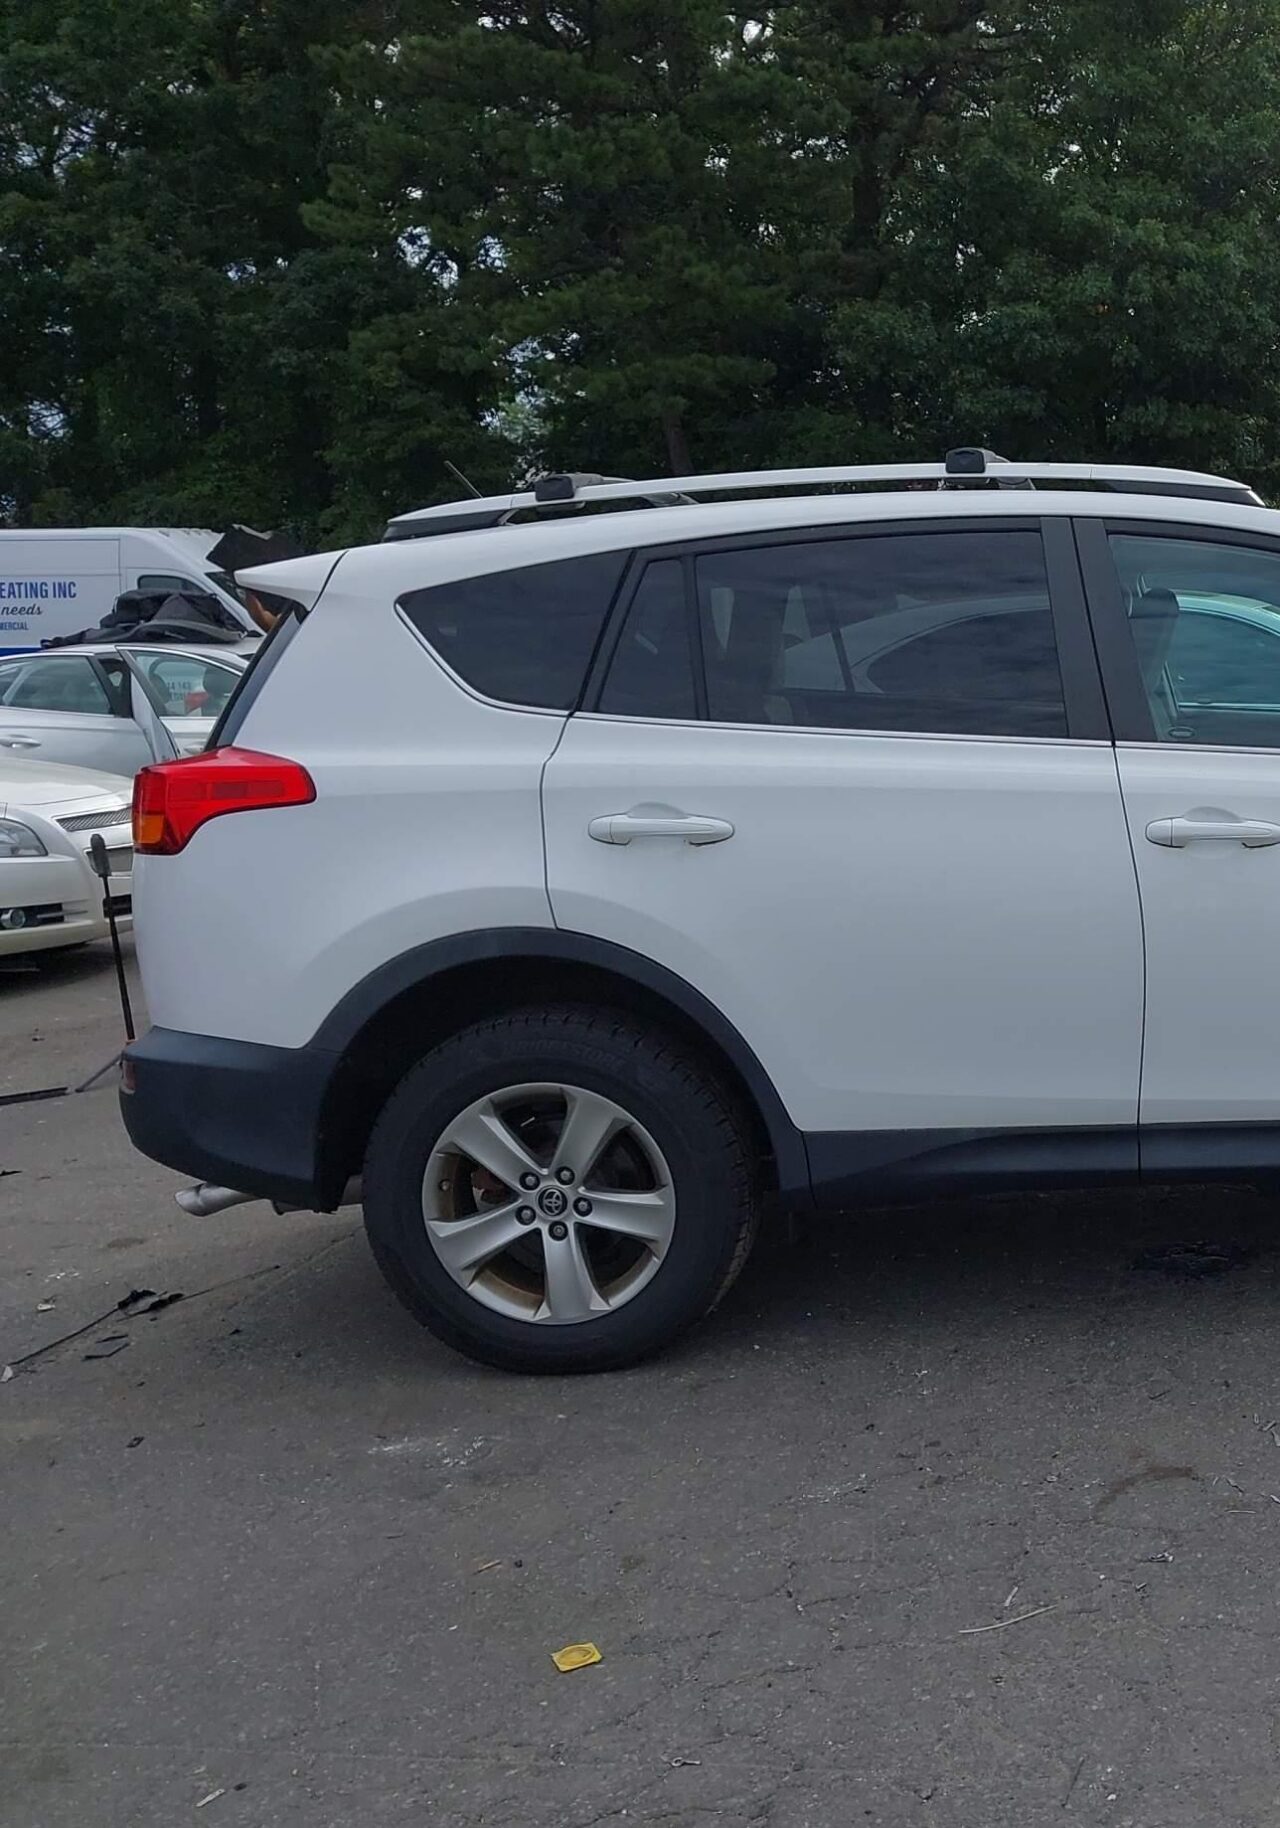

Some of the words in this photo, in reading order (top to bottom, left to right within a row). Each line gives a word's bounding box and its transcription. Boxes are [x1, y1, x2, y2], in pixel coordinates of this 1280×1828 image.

[0, 581, 48, 599] EATING
[53, 581, 77, 599] INC
[1, 603, 42, 615] needs
